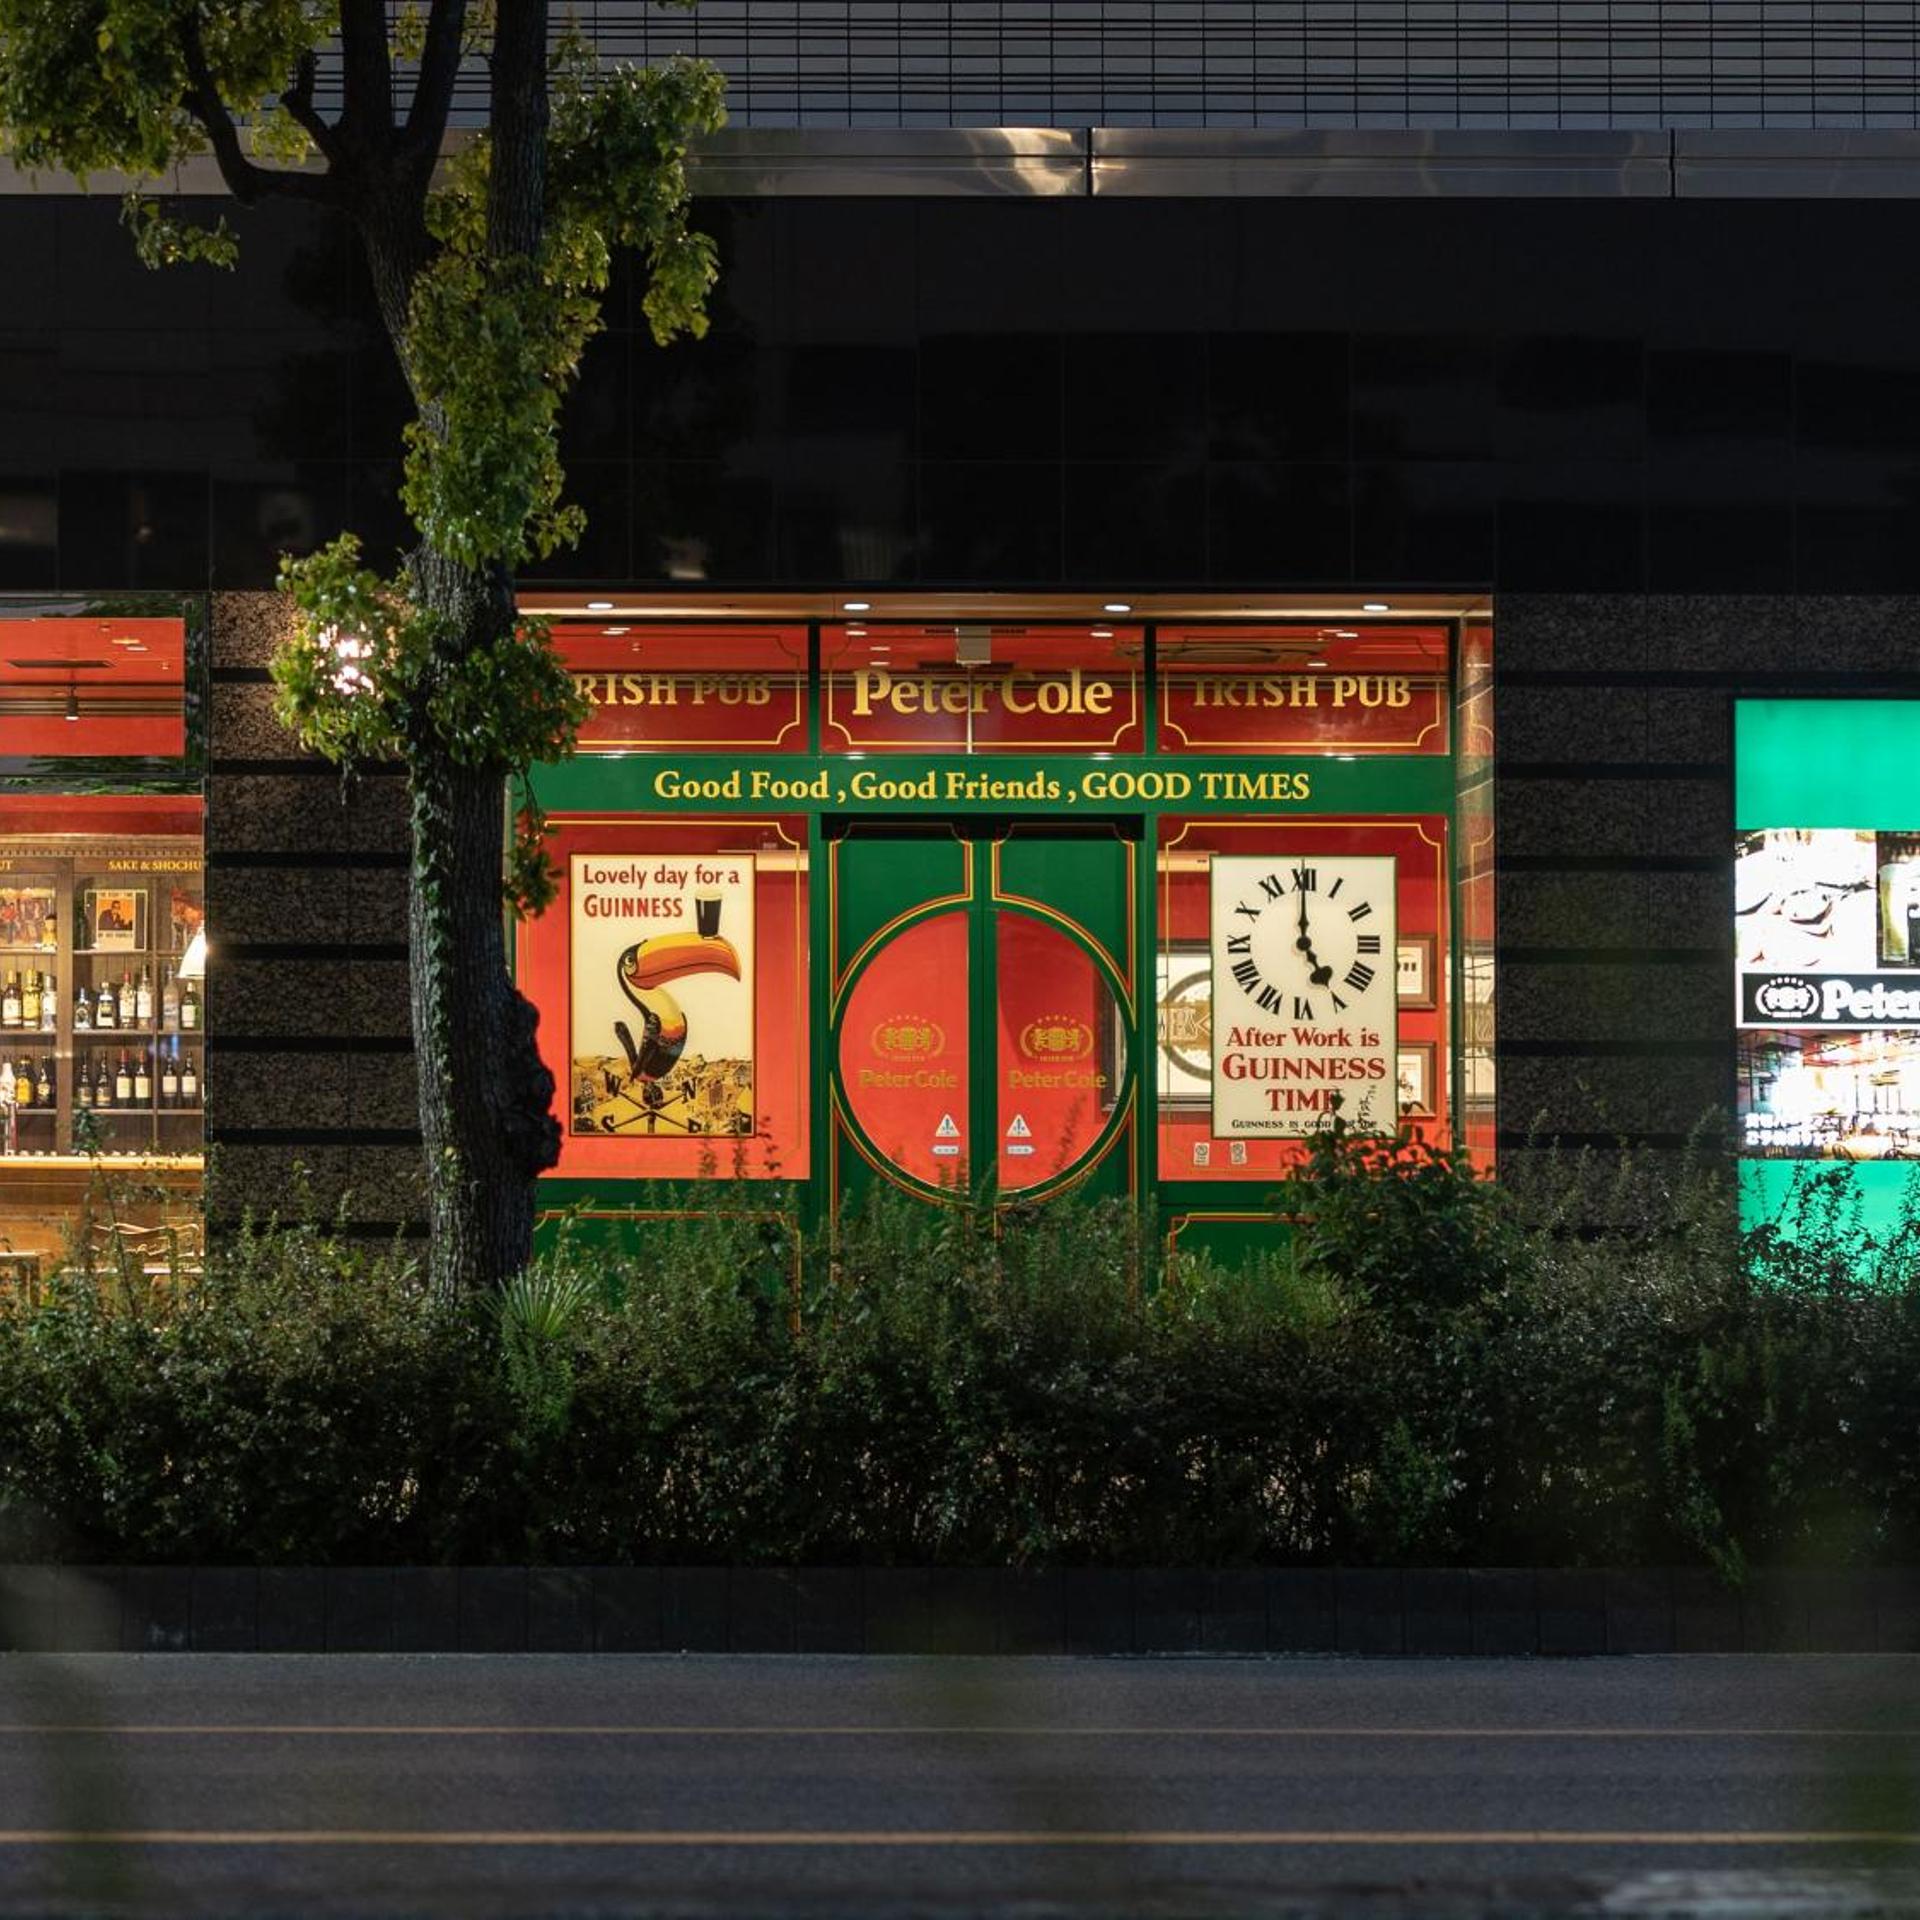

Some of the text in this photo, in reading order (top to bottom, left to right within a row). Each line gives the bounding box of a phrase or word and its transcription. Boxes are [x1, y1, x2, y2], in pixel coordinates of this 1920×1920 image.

[571, 674, 771, 705] RISH PUB
[852, 667, 1113, 715] Peter Cole
[1194, 675, 1411, 707] IRISH PUB
[654, 769, 742, 798] Good
[1198, 773, 1311, 800] TIMES
[109, 860, 202, 871] SAKE & SHOCHU
[583, 864, 740, 890] Lovely day for a
[1258, 874, 1285, 903] XI
[1291, 869, 1316, 892] XII
[584, 894, 684, 918] GUINNESS
[1234, 901, 1261, 924] X
[1347, 901, 1372, 923] II
[1227, 935, 1251, 954] IX
[1357, 935, 1380, 954] III
[1230, 958, 1262, 995] VIII
[1256, 984, 1283, 1015] VII
[1294, 996, 1313, 1020] VI
[1331, 991, 1348, 1014] V
[1226, 1027, 1380, 1047] After Work is
[1222, 1053, 1386, 1080] GUINNESS
[859, 1069, 958, 1088] Peter Cole
[1009, 1069, 1107, 1088] Peter Cole
[1231, 1119, 1284, 1129] GUINNESS
[1289, 1120, 1299, 1129] IS
[1304, 1120, 1331, 1129] GOOD
